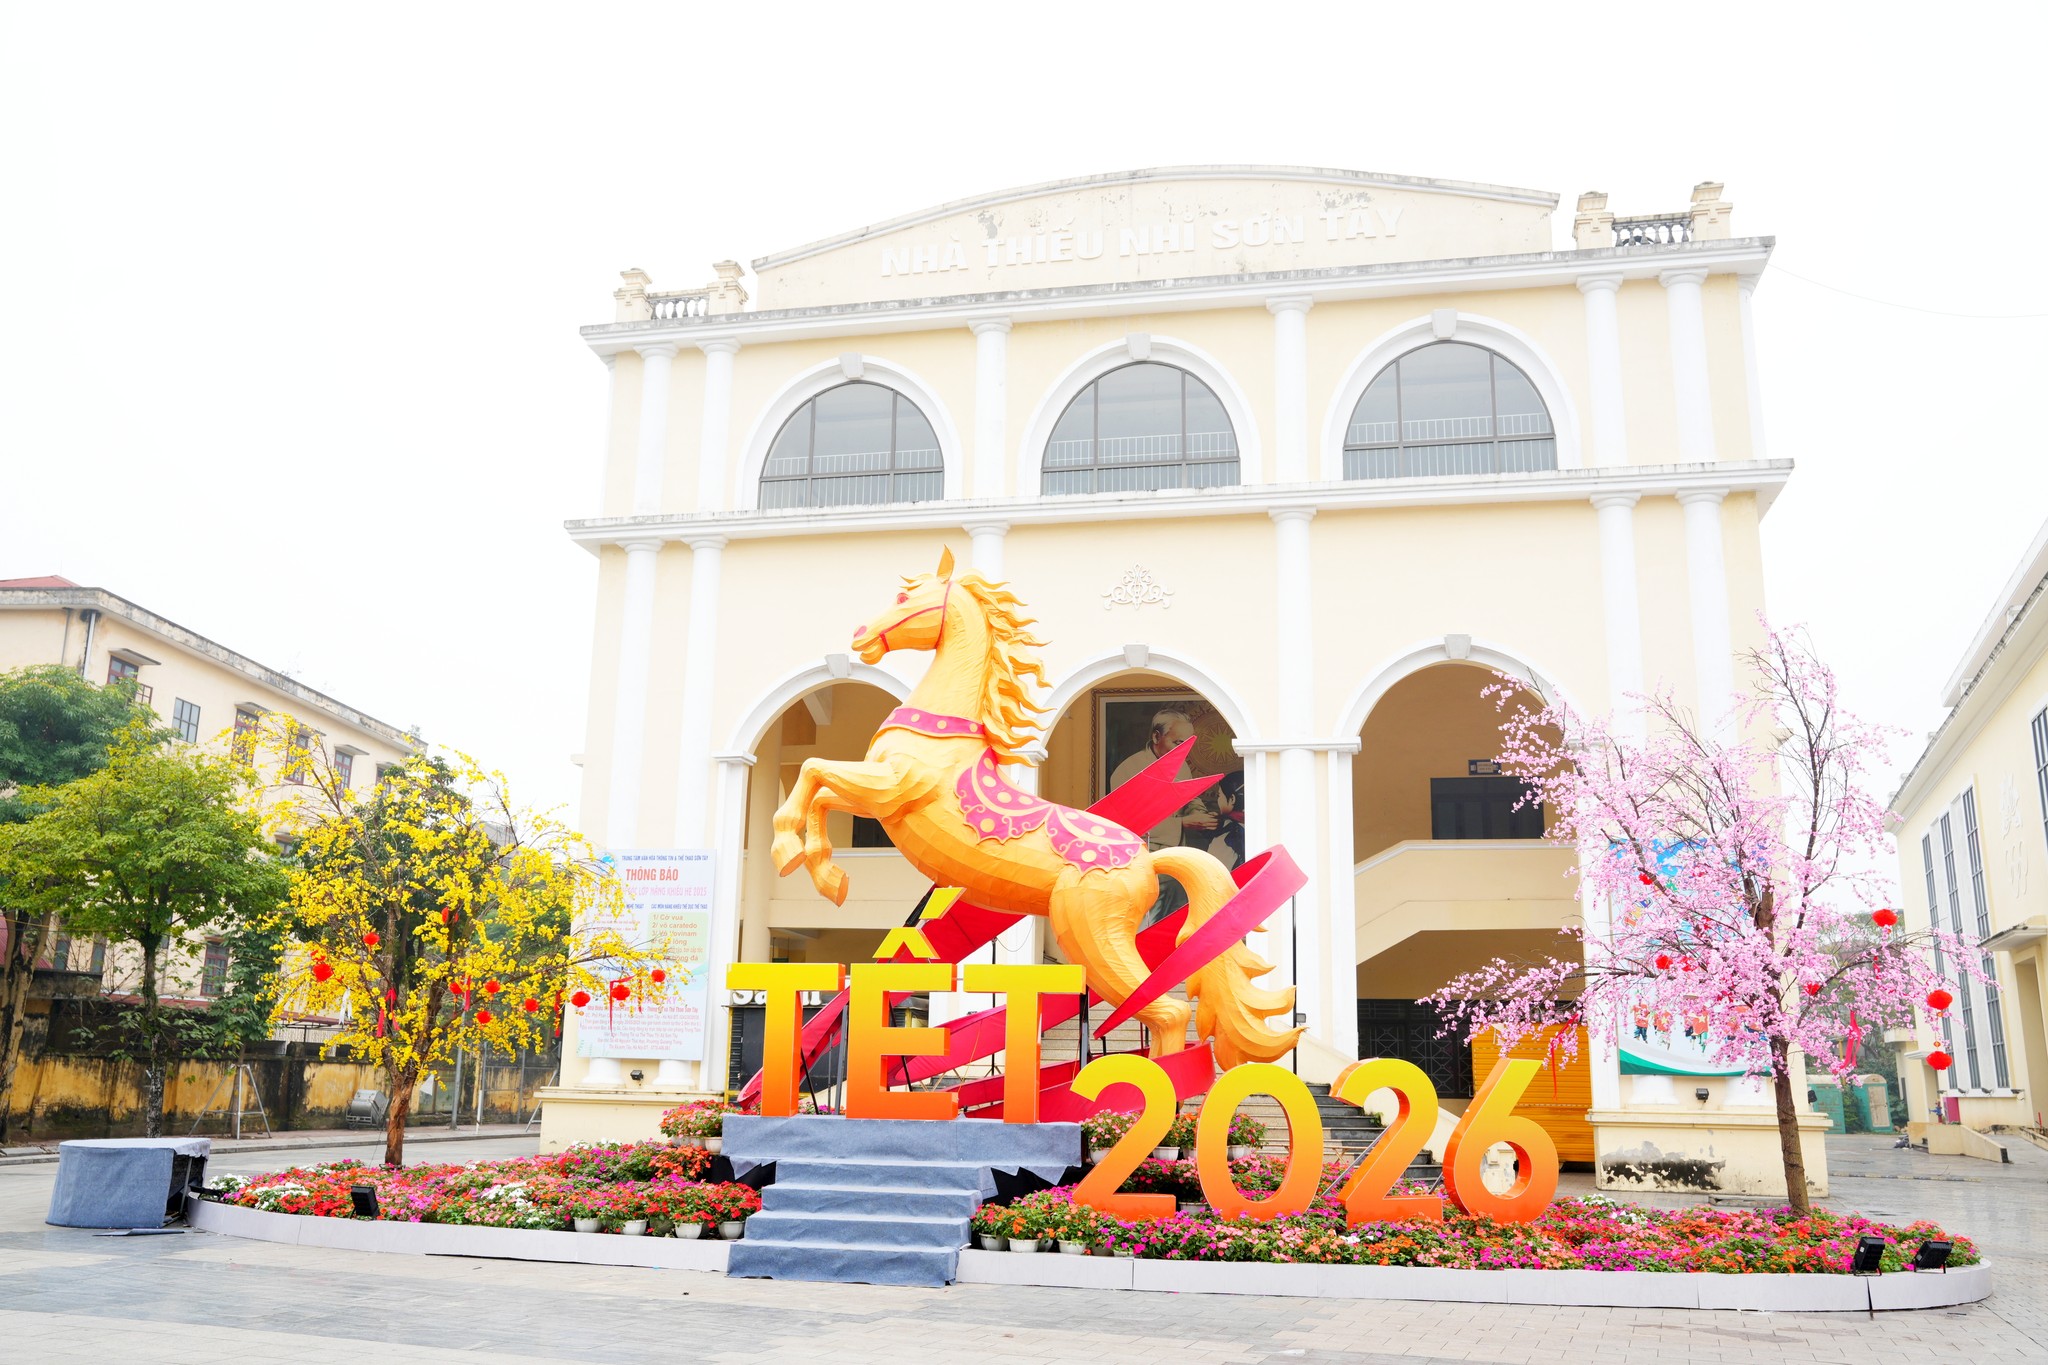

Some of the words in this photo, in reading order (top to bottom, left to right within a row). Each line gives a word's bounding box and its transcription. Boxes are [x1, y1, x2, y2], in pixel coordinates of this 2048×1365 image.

[881, 231, 969, 278] NHÀ
[1211, 211, 1305, 250] SƠN
[1318, 200, 1405, 241] TÂY
[626, 866, 657, 881] THÔNG
[660, 866, 679, 881] BÁO
[726, 887, 1088, 1124] TẾT
[1070, 1053, 1559, 1229] 2026
